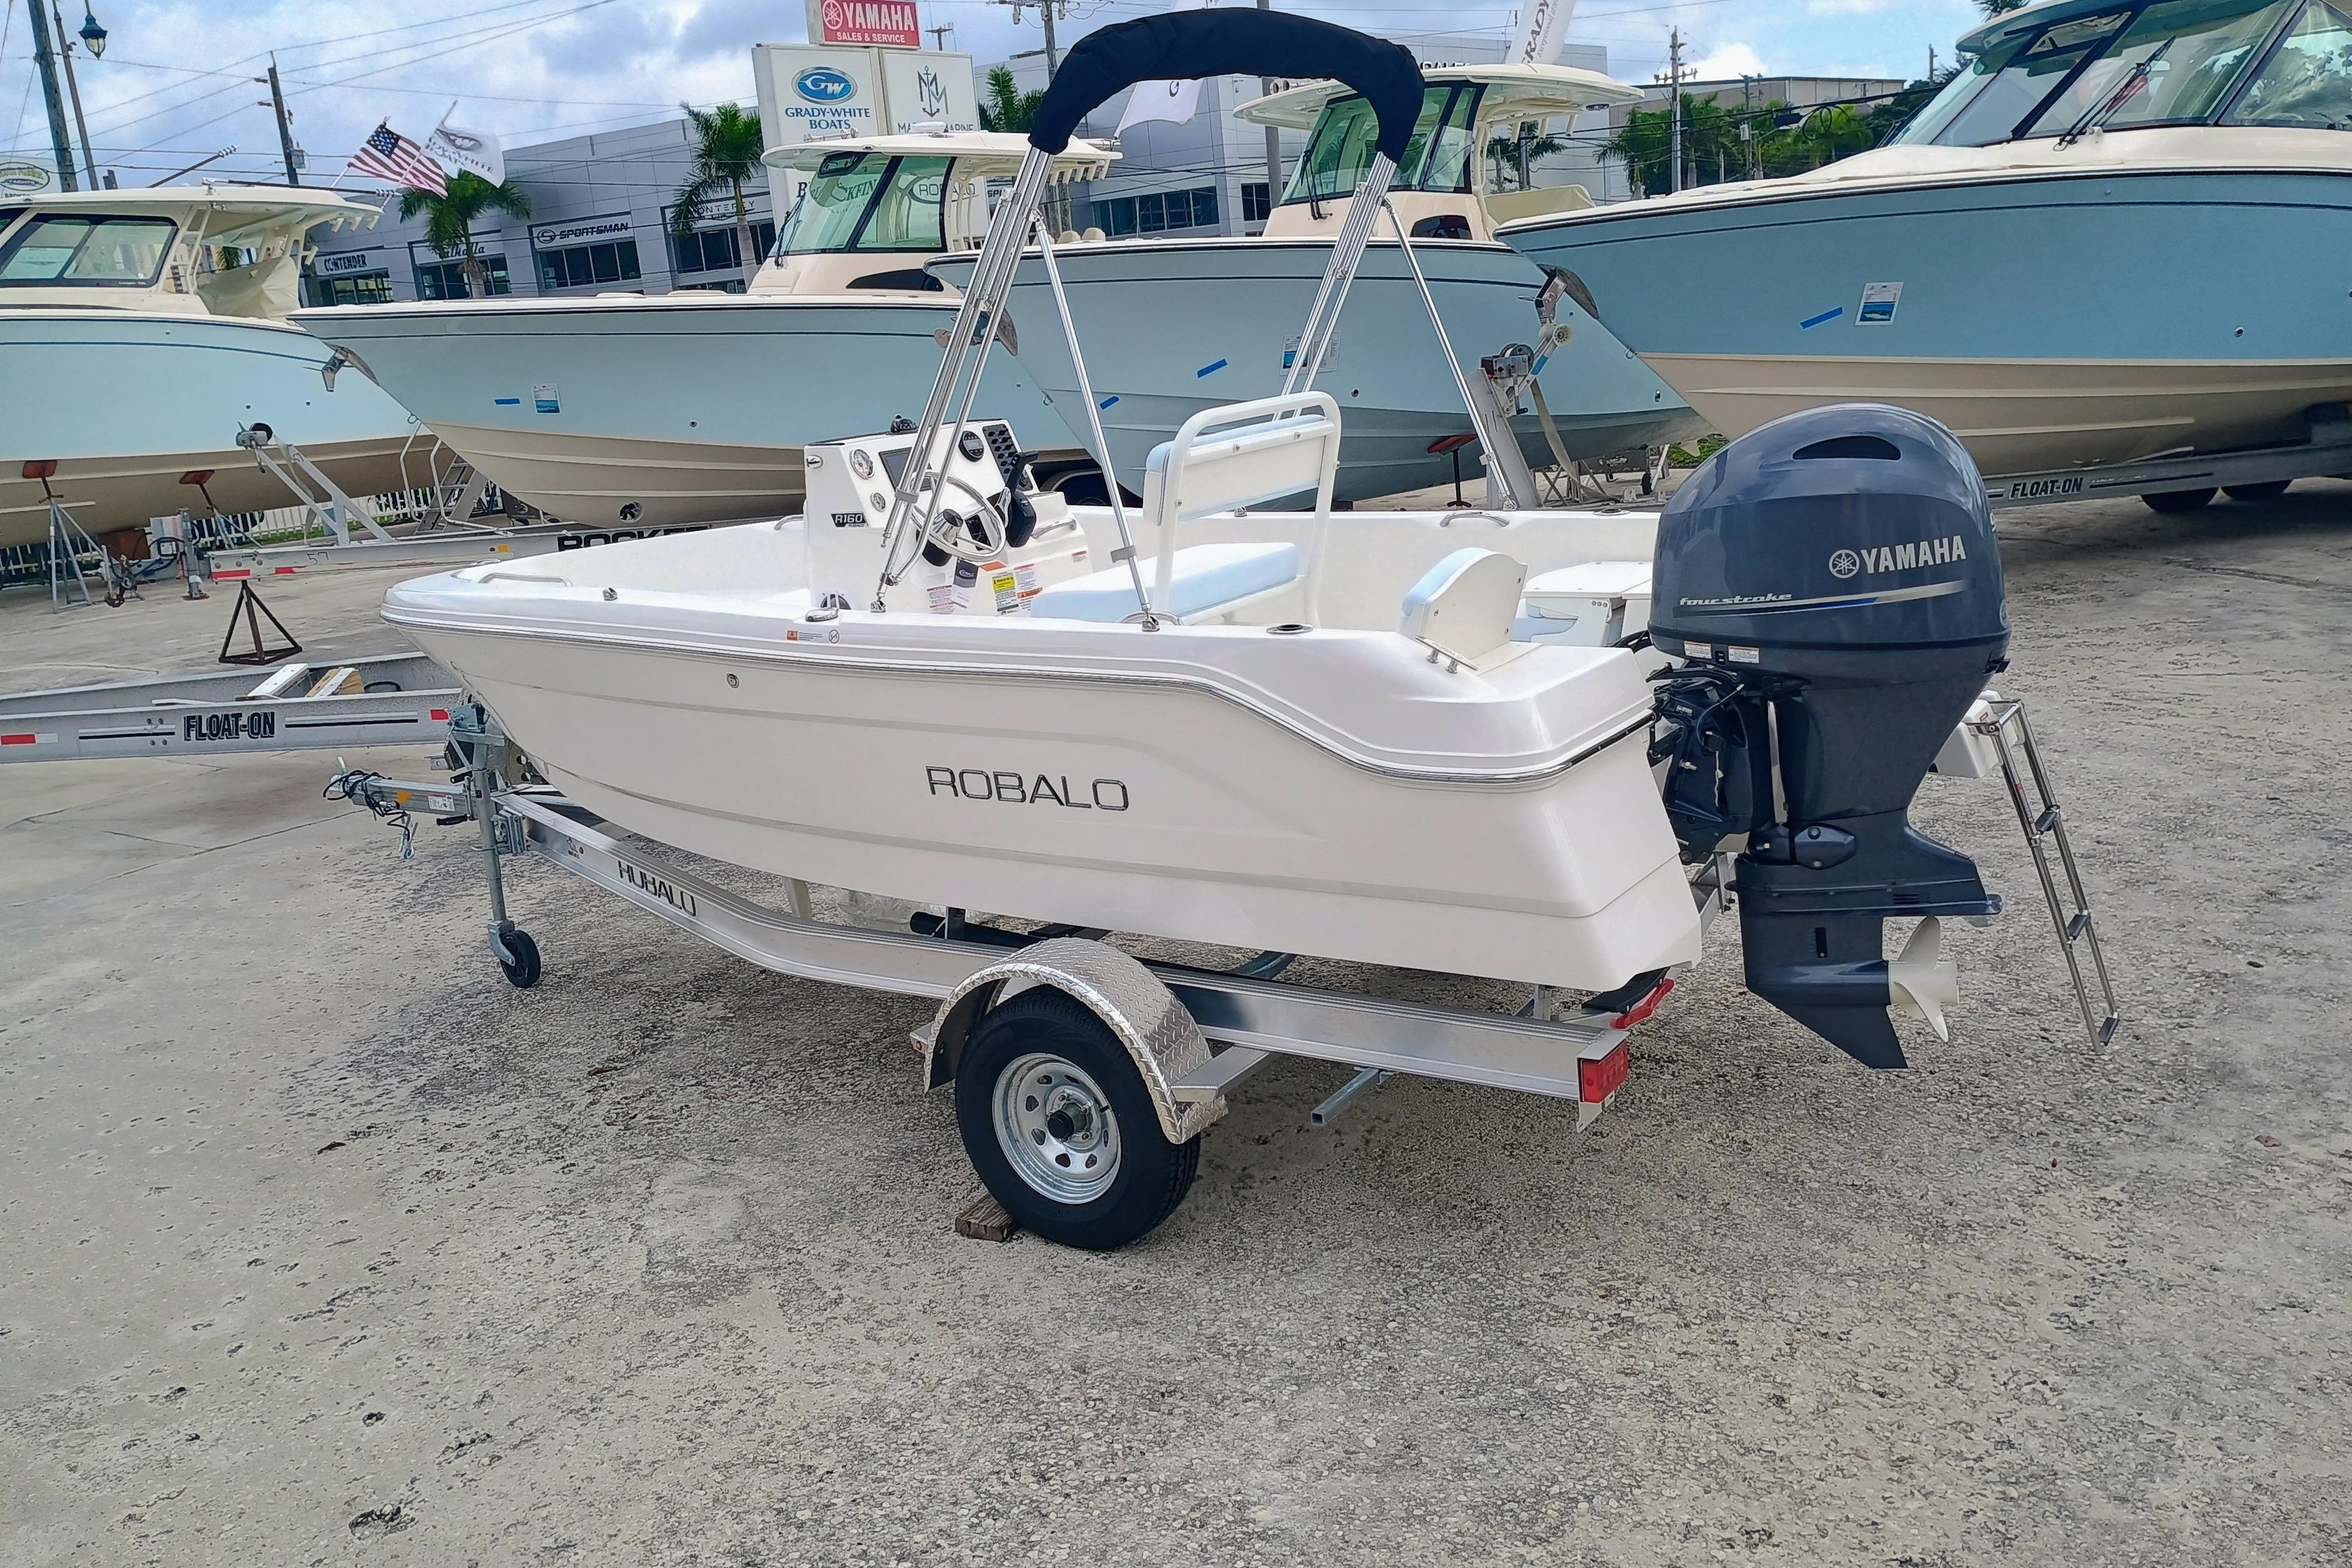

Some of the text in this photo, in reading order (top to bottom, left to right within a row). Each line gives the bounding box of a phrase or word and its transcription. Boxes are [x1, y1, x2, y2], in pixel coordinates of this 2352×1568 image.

[842, 2, 915, 32] YAMAHA
[837, 32, 906, 43] SALES & SERVICE
[785, 107, 871, 118] GRADY-WHITE
[809, 119, 851, 130] BOATS
[559, 222, 629, 239] SPORTSMAN
[324, 254, 368, 272] CONTENDER
[2009, 477, 2083, 501] FLOAT-ON
[835, 514, 863, 524] R160
[1860, 535, 1967, 574] YAMAHA
[183, 711, 275, 741] FLOAT-ON
[926, 765, 1129, 811] ROBALO
